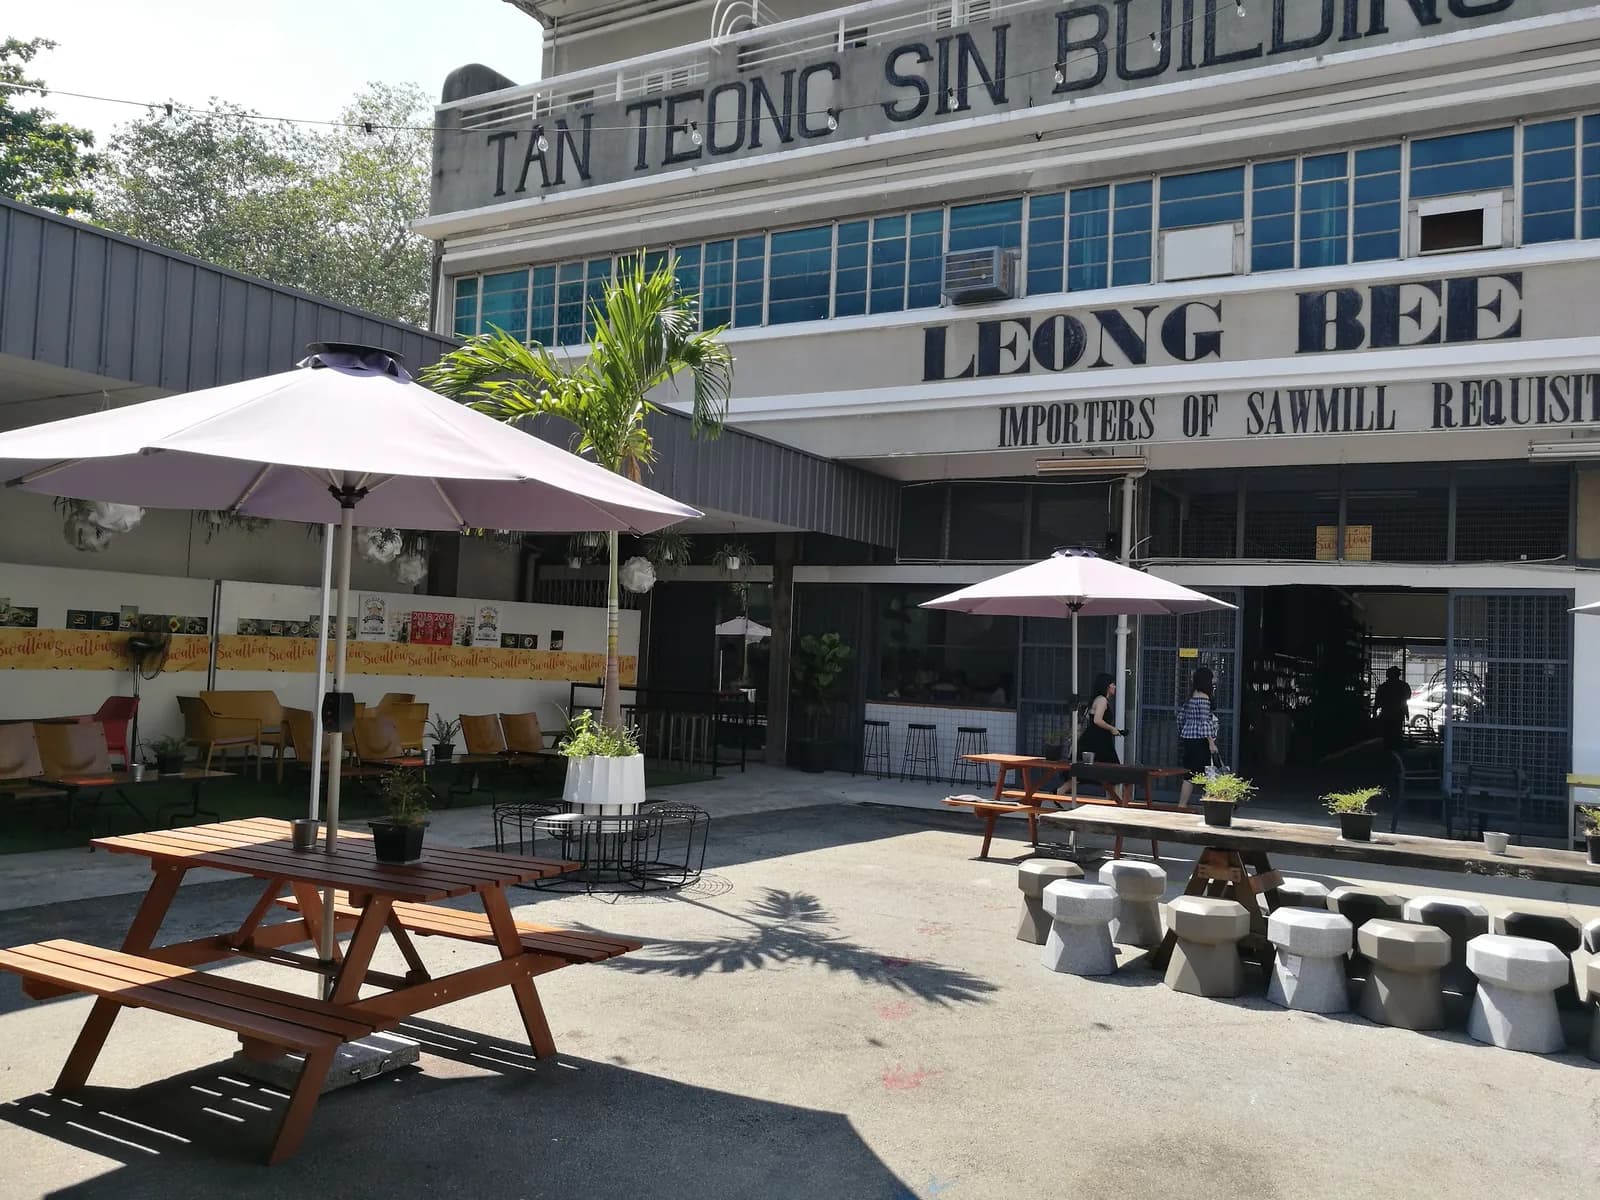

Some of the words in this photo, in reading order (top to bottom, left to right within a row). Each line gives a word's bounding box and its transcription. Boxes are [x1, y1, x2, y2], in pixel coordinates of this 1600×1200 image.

[487, 112, 594, 197] TAN
[883, 23, 1010, 122] SIN
[1052, 0, 1513, 94] BUILDI
[923, 299, 1223, 382] LEONG
[1295, 271, 1523, 355] BEE
[998, 397, 1155, 448] IMPORTERS
[1182, 393, 1219, 437] OF
[1246, 385, 1396, 437] SAWMILL
